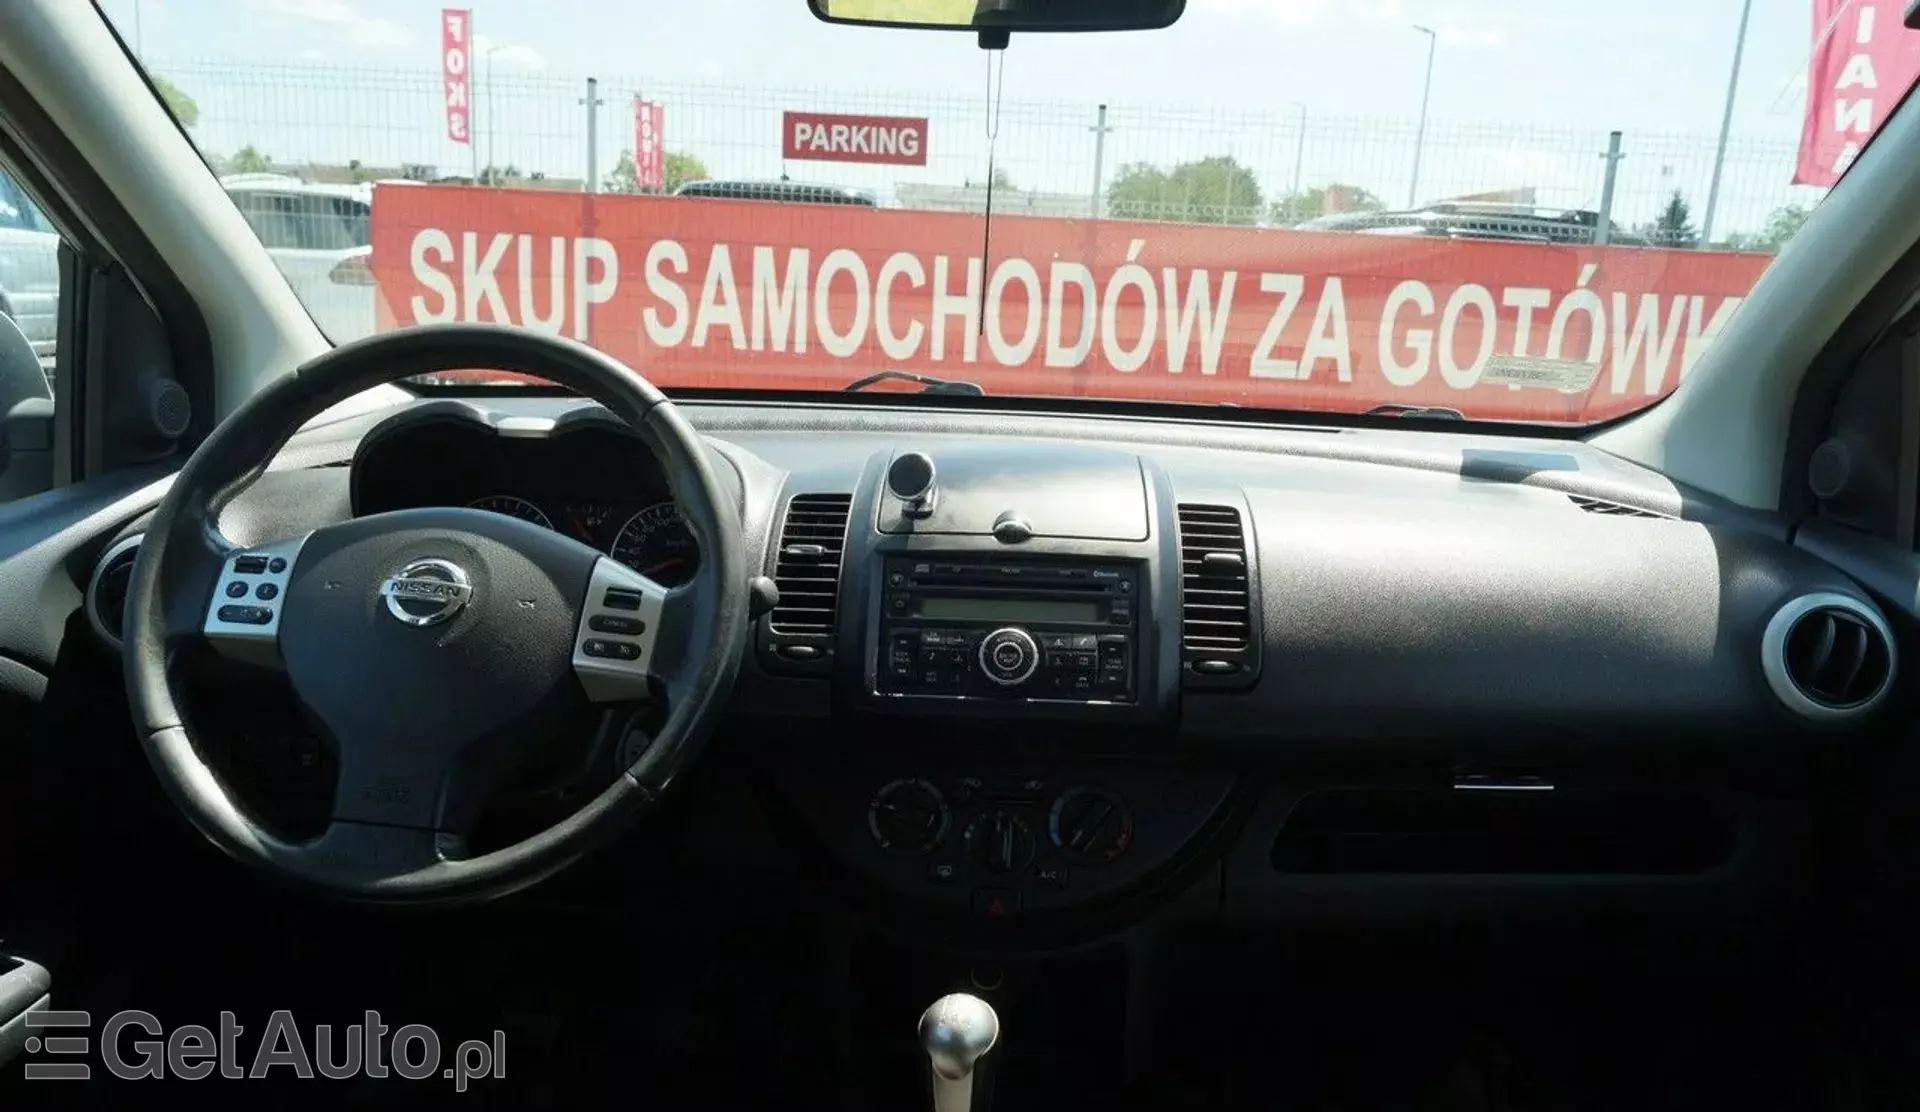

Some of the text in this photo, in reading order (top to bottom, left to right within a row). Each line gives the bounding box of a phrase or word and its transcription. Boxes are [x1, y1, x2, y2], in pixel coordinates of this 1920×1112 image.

[794, 123, 920, 156] PARKING
[410, 228, 618, 341] SKUP
[642, 239, 1238, 375] SAMOCHODÓW
[1249, 272, 1353, 383] ZA
[390, 580, 462, 598] NISSAN
